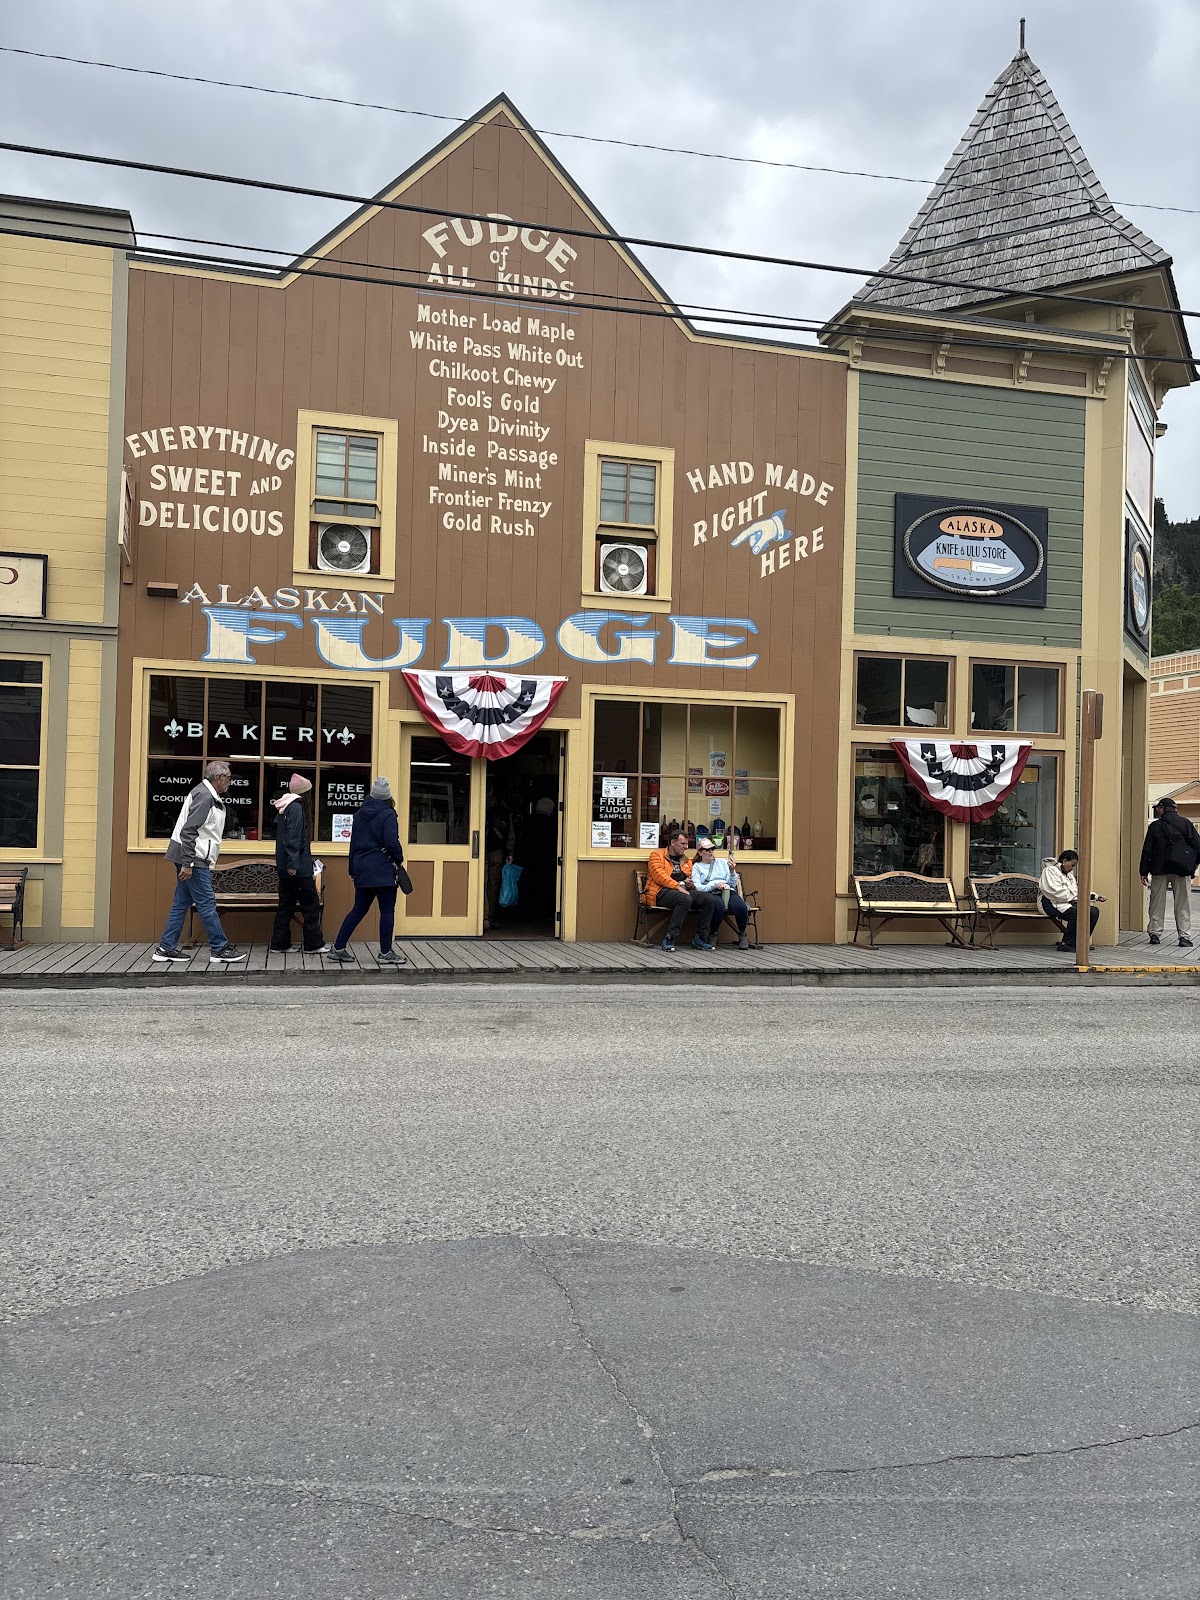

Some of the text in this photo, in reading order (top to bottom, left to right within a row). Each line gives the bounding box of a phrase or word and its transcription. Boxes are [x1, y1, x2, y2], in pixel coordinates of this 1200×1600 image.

[421, 213, 578, 273] FUDGE
[489, 246, 509, 271] of
[427, 262, 575, 301] ALL KINDS
[417, 304, 575, 343] Mother Load Maple
[409, 331, 584, 368] White Pass White Out
[429, 359, 557, 393] Chilkoot Chewy
[447, 387, 540, 413] Fool's Gold
[438, 410, 550, 442] Dyea Divinity
[125, 425, 295, 471] EVERYTHING
[423, 435, 558, 470] Inside Passage
[150, 464, 282, 497] SWEET AND
[438, 463, 542, 489] Miner's Mint
[686, 461, 835, 506] HAND MADE
[429, 486, 552, 518] Frontier Frenzy
[138, 500, 284, 537] DELICIOUS
[442, 511, 535, 537] Gold Rush
[692, 490, 768, 547] RIGHT
[947, 520, 996, 534] ALASKA
[760, 526, 824, 579] HERE
[936, 542, 1007, 559] KNIFE & ULU STORE
[951, 573, 993, 582] SKAGWAY
[179, 582, 385, 615] ALASKAN
[201, 607, 760, 671] FUDGE
[187, 722, 337, 744] BAKERY
[159, 776, 193, 784] CANDY
[327, 783, 365, 793] FREE
[327, 792, 365, 800] FUDGE
[152, 794, 253, 805] COOKI CONES
[599, 806, 632, 814] FUDGE
[600, 797, 632, 806] FREE
